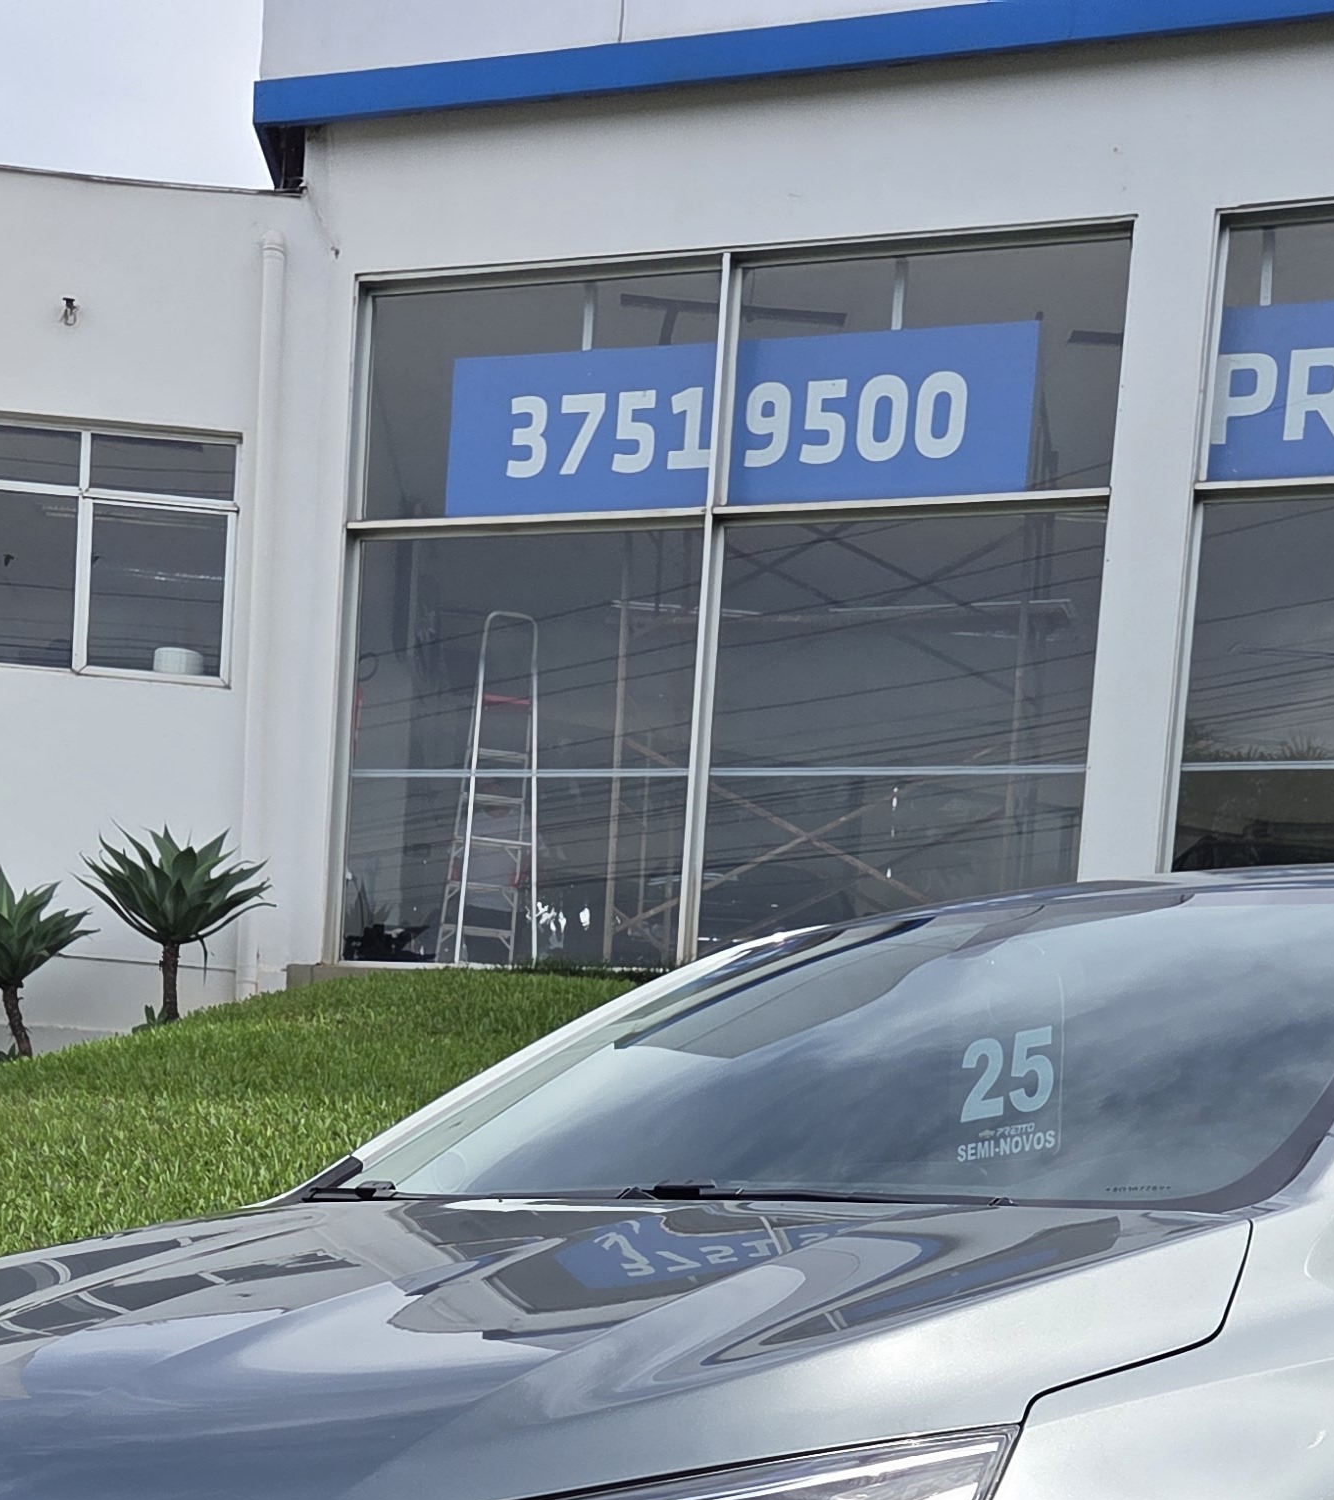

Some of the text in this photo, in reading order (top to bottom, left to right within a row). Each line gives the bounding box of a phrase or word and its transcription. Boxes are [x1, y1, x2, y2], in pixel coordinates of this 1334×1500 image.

[505, 370, 968, 479] 3751 9500
[960, 1025, 1055, 1123] 25
[956, 1130, 1056, 1162] SEMI-NOVOS
[996, 1123, 1035, 1137] PRETTO
